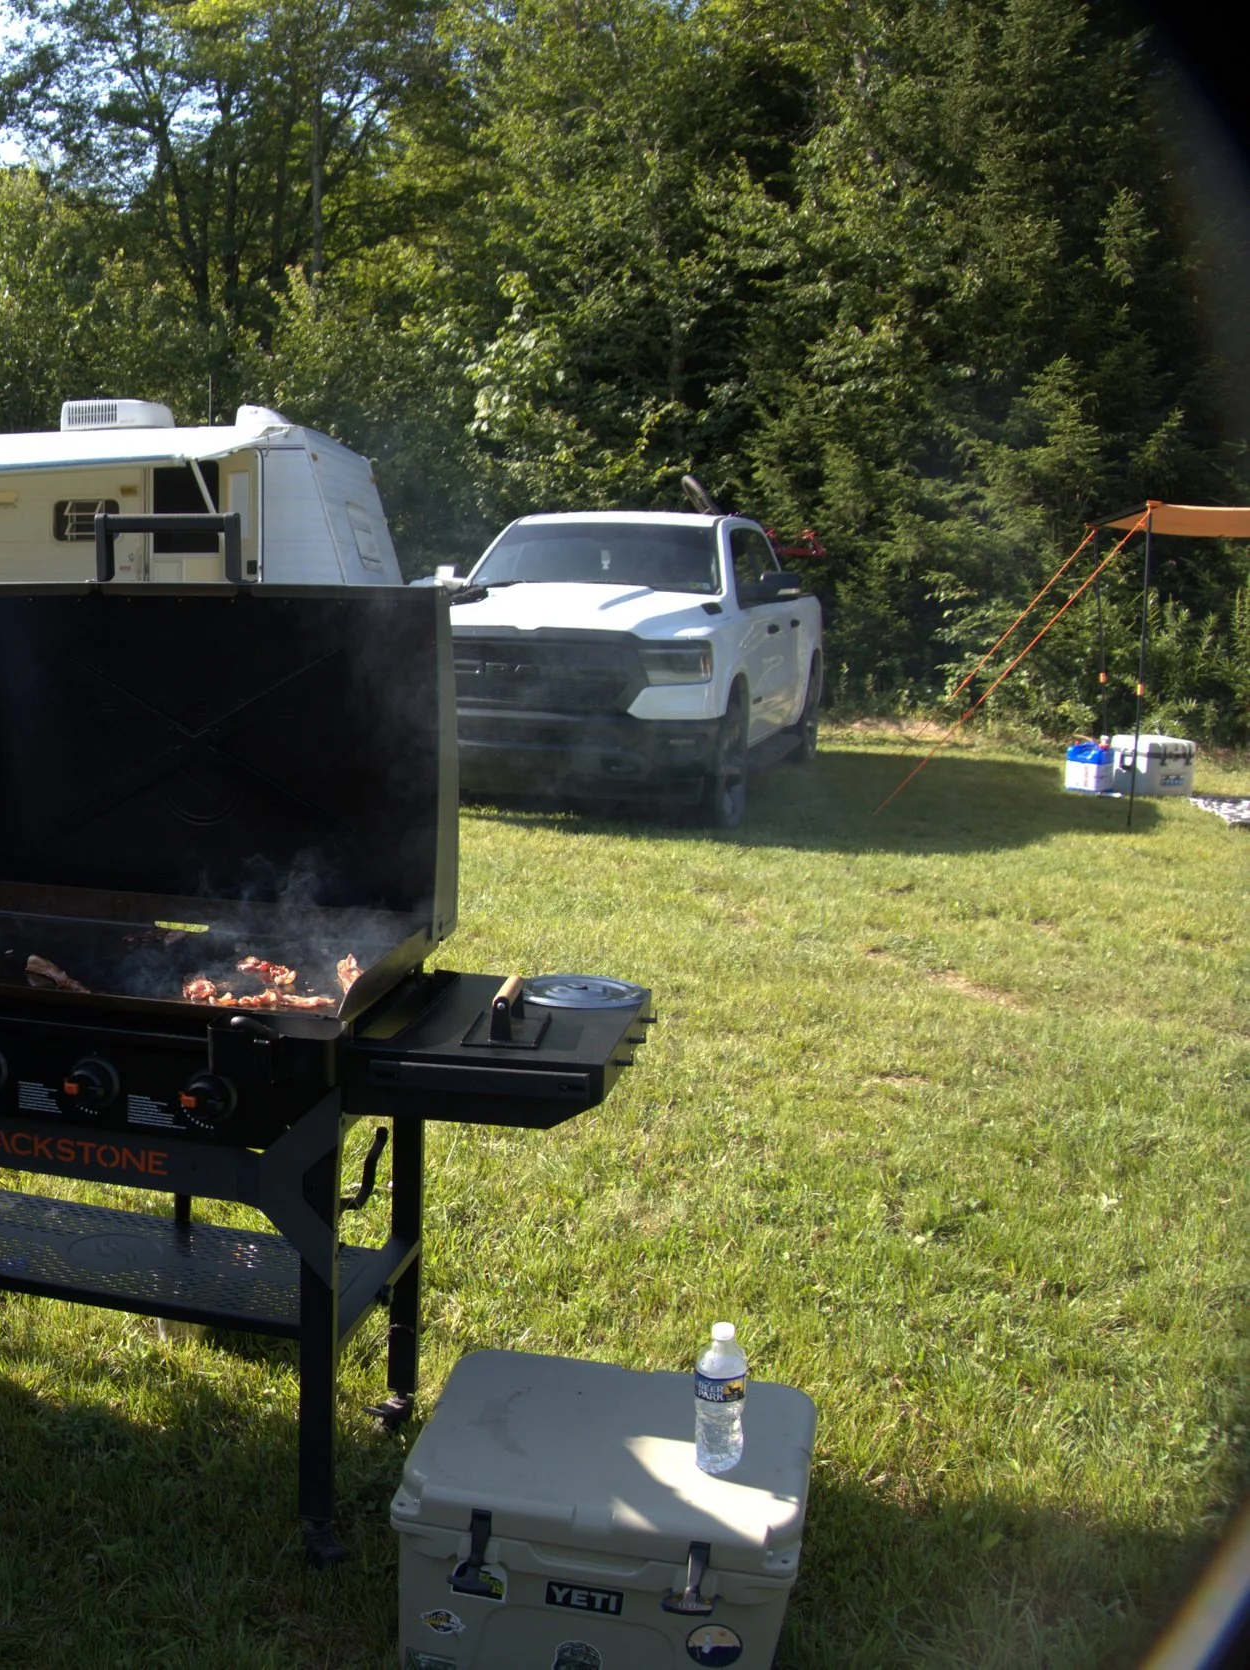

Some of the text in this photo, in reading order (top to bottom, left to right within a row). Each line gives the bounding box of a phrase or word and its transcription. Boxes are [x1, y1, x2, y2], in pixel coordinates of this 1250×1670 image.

[698, 1381, 723, 1393] DEER
[698, 1390, 724, 1401] PARK
[551, 1586, 617, 1612] YETI
